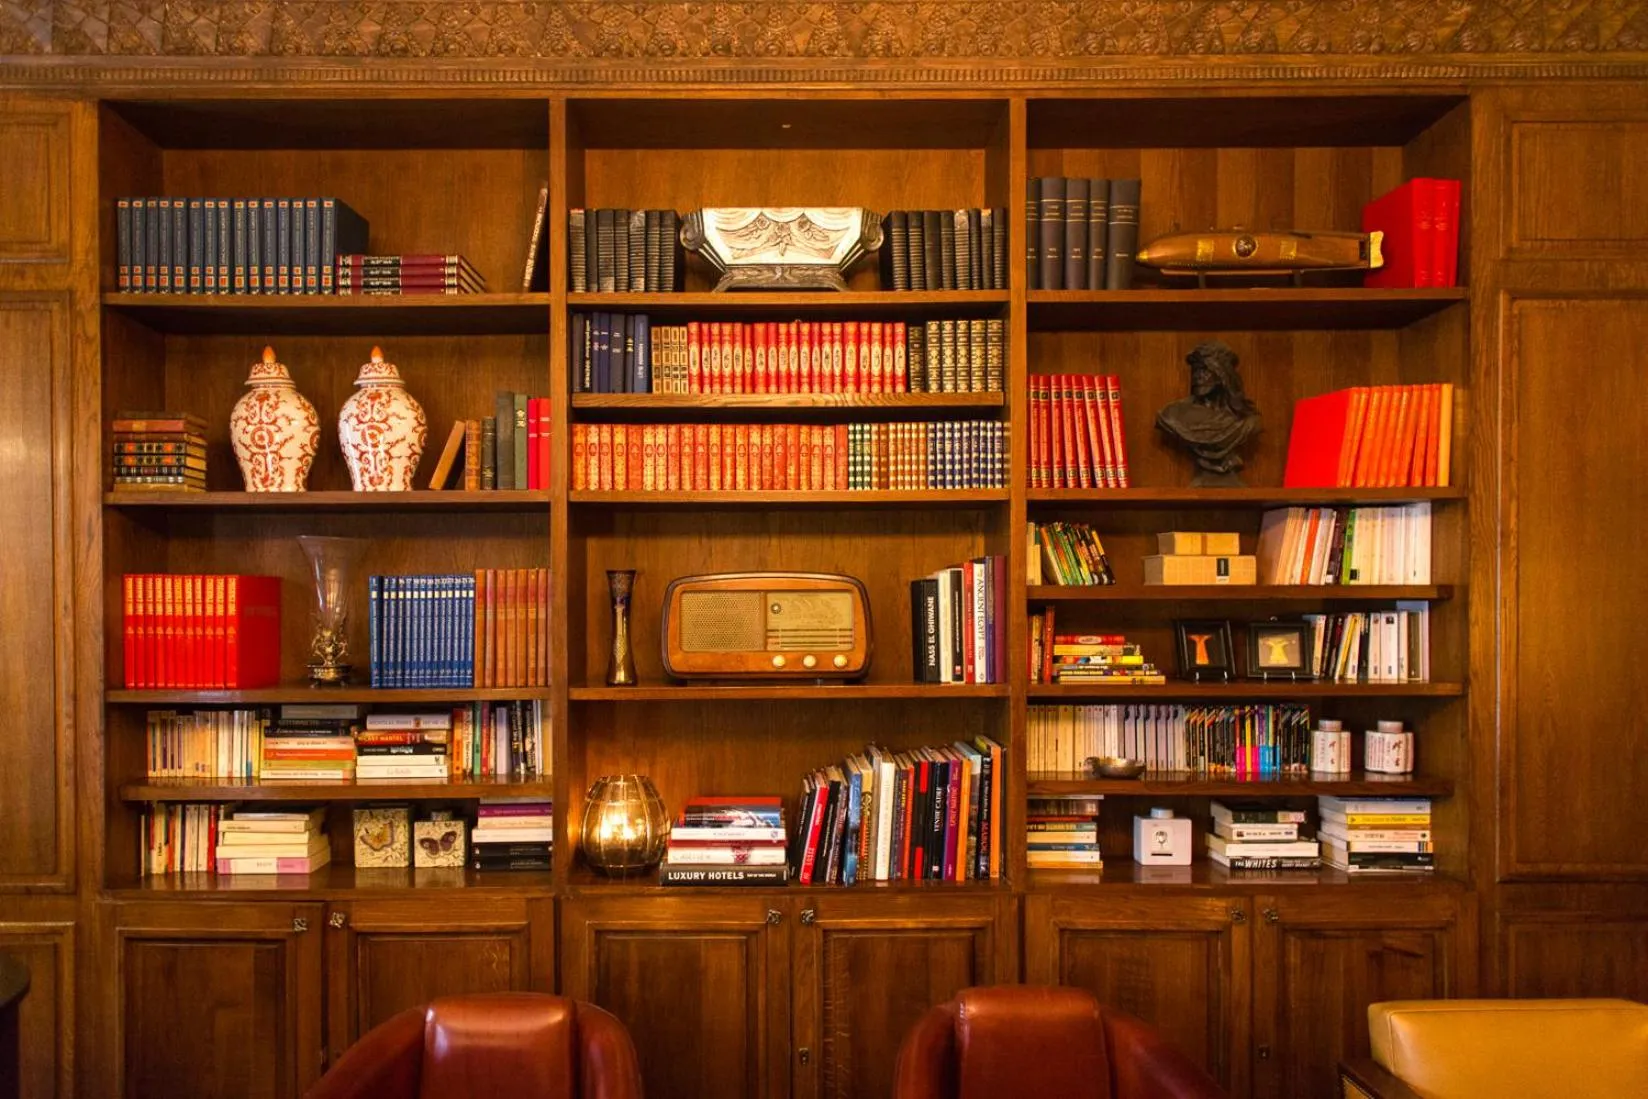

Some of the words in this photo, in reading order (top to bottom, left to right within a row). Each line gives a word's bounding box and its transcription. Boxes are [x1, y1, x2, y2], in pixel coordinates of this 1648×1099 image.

[977, 579, 985, 612] ANCIENT
[927, 596, 935, 634] GHIWANE
[928, 644, 936, 666] NASS
[1244, 859, 1278, 869] WHITES
[668, 871, 706, 881] LUXURY
[708, 871, 744, 881] HOTELS
